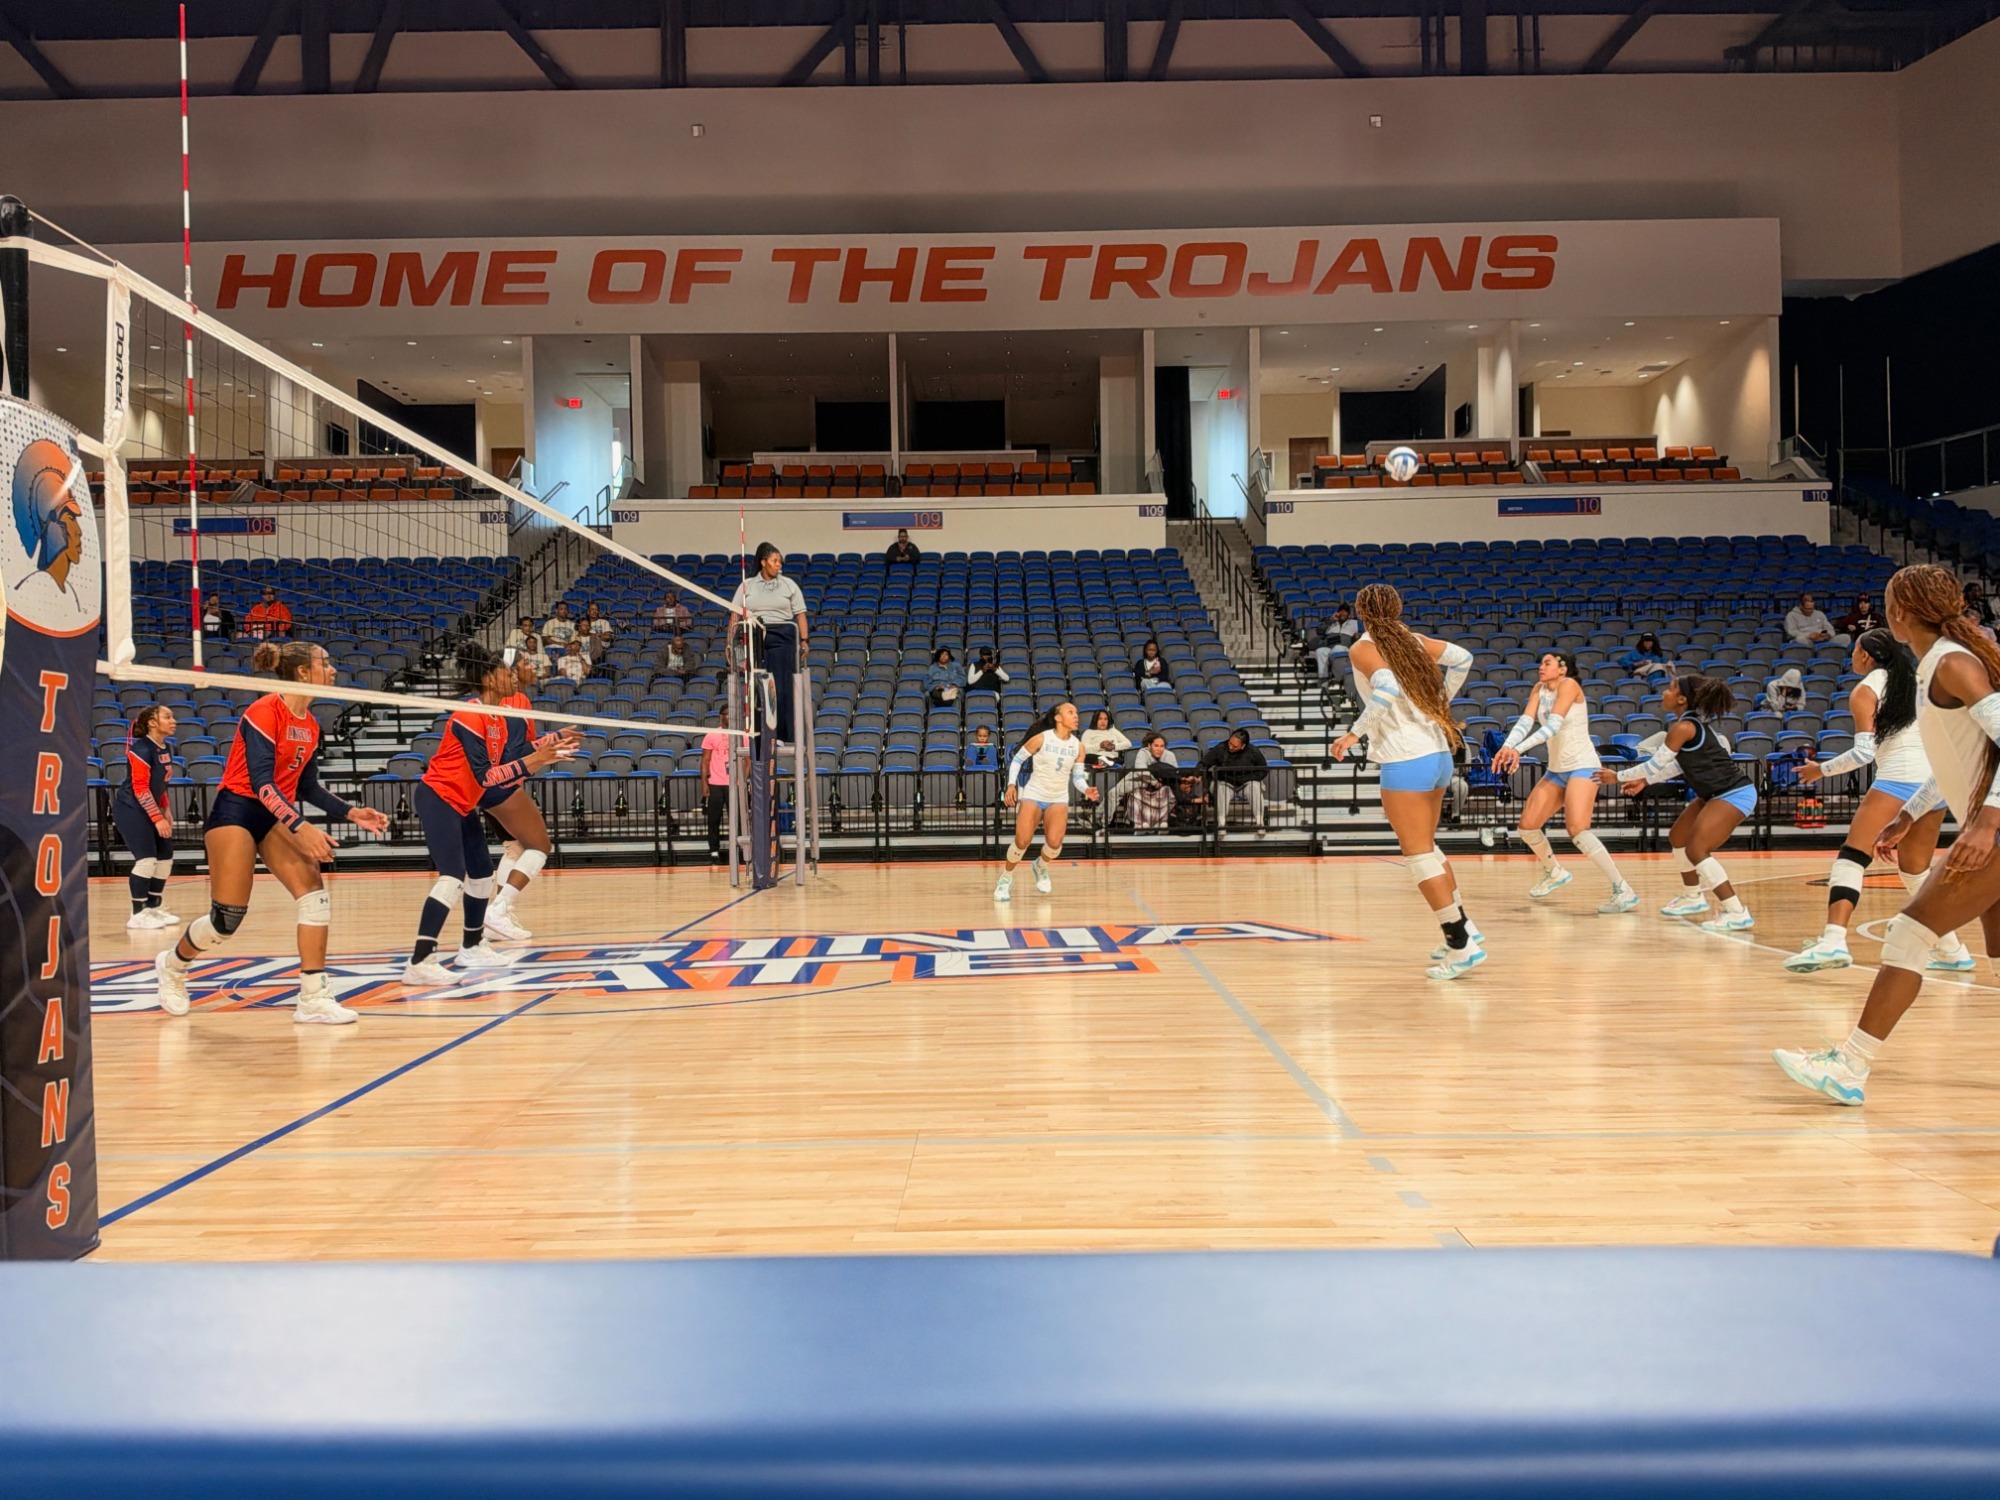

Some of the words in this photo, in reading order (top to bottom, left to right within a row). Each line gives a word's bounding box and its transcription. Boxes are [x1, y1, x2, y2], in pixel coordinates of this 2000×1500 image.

[216, 250, 557, 309] HOME
[588, 249, 743, 304] OF
[771, 246, 996, 303] THE
[1023, 235, 1558, 301] TROJANS
[1811, 490, 1828, 501] 110
[1145, 505, 1164, 517] 109
[1275, 502, 1292, 513] 110
[1576, 498, 1600, 514] 110
[486, 512, 506, 523] 108
[617, 511, 638, 522] 109
[913, 512, 941, 528] 109
[245, 518, 273, 533] 108
[288, 746, 304, 770] 5
[1055, 757, 1065, 771] 5
[33, 670, 70, 1228] TROJANS
[90, 921, 1335, 986] IRGINIA
